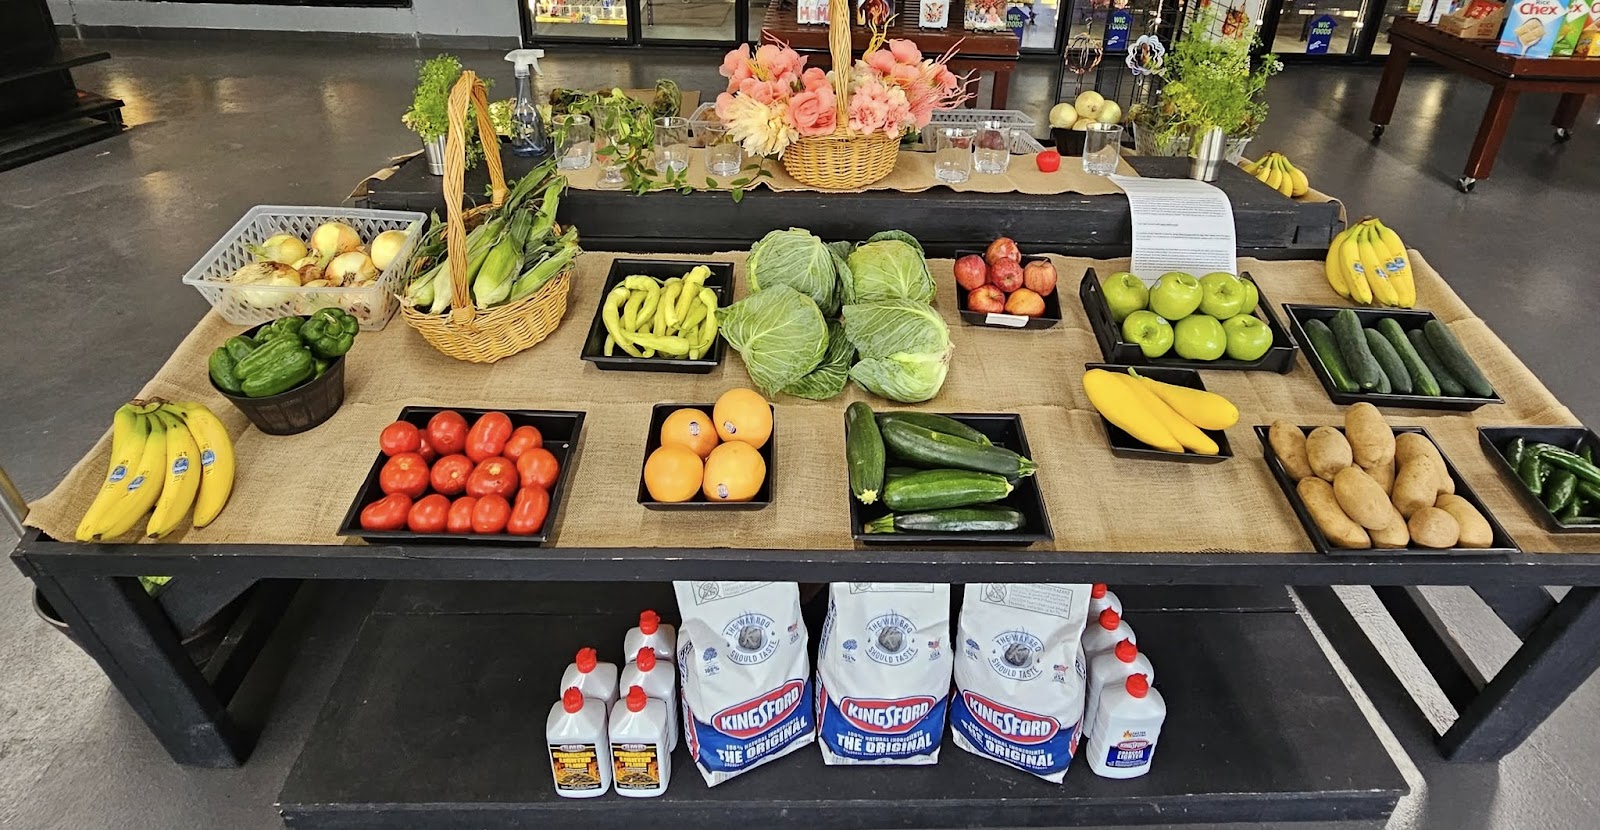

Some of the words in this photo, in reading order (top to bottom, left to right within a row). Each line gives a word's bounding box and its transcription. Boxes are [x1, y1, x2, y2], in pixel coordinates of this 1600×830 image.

[1520, 3, 1558, 15] Chex
[1114, 16, 1126, 24] WIC
[726, 622, 739, 636] THE
[738, 616, 755, 628] WAY
[868, 620, 882, 632] THE
[882, 616, 898, 626] WAY
[900, 619, 912, 634] BBQ
[730, 650, 758, 663] SHOULD
[760, 640, 776, 660] TASTE
[996, 634, 1010, 646] THE
[1011, 634, 1028, 644] WAY
[1029, 638, 1042, 652] BBQ
[868, 646, 894, 663] SHOULD
[896, 648, 915, 662] TASTE
[992, 658, 1016, 677] SHOULD
[1019, 666, 1040, 678] TASTE
[720, 686, 799, 730] KINGSFORD
[848, 702, 929, 730] KINGSFORD
[969, 696, 1051, 736] KINGSFORD
[716, 748, 744, 764] THE
[746, 716, 808, 759] ORIGINAL
[744, 735, 768, 750] NATURAL
[836, 734, 862, 752] THE
[866, 732, 932, 754] ORIGINAL
[960, 719, 984, 743] THE
[986, 740, 1054, 767] ORIGINAL
[984, 733, 1008, 747] NATURAL
